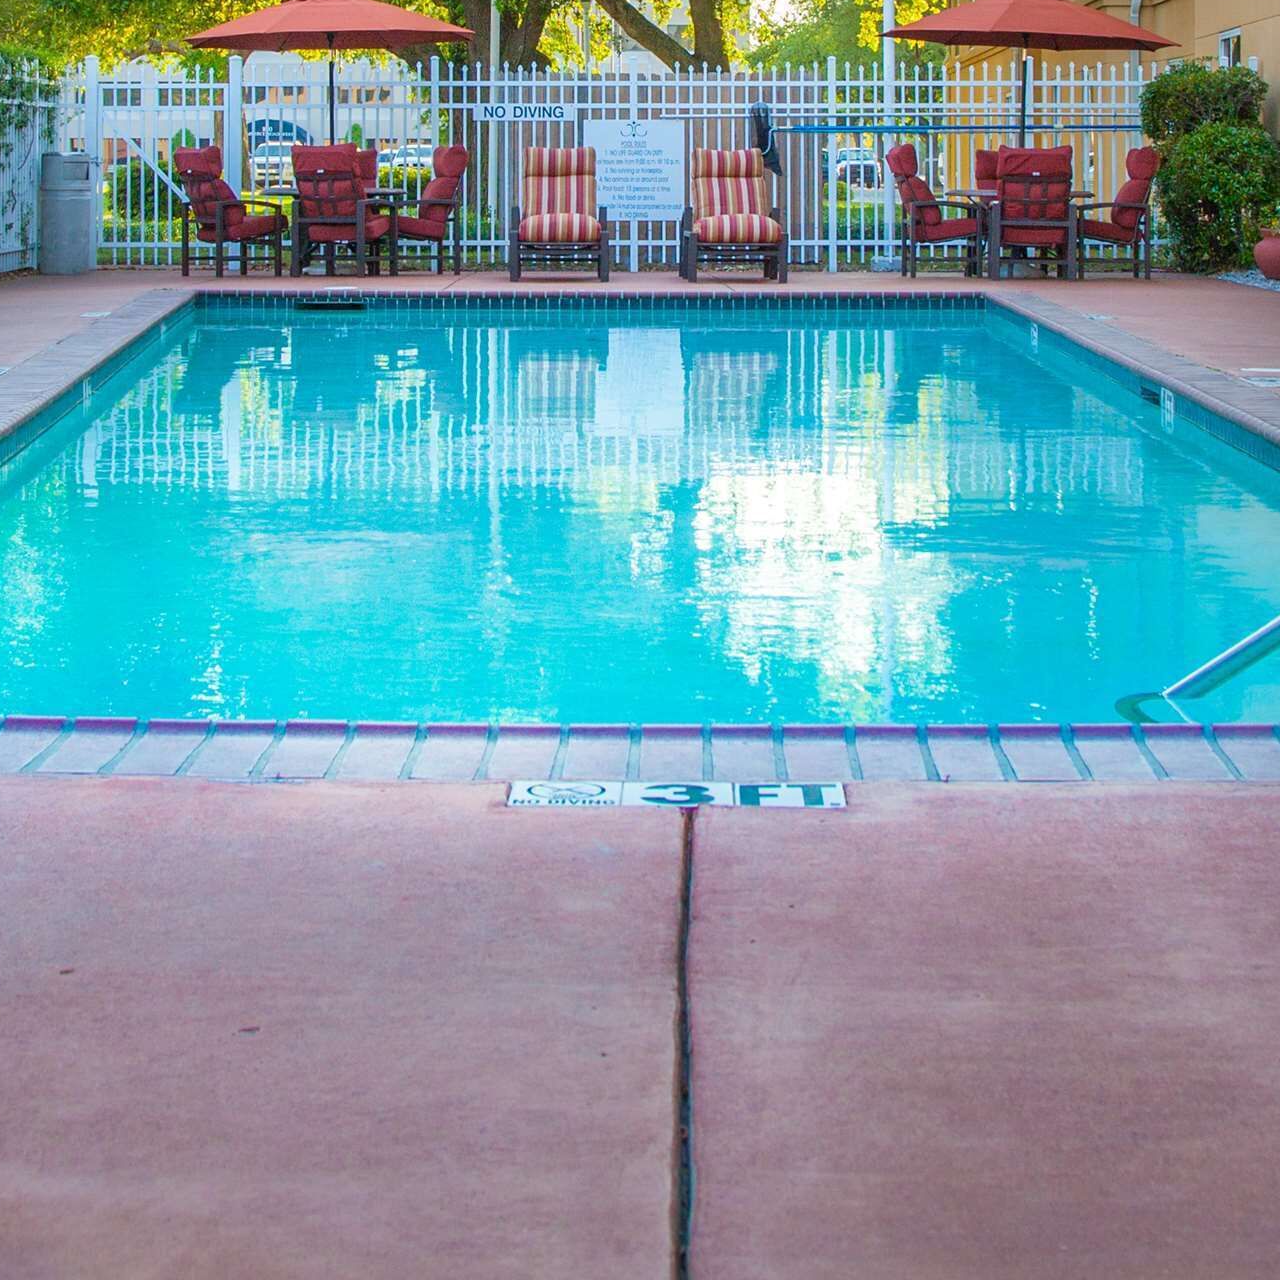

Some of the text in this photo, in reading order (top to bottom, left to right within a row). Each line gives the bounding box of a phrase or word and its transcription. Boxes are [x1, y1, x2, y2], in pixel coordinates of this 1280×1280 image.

[483, 106, 564, 119] NO DIVING
[640, 783, 716, 807] 3
